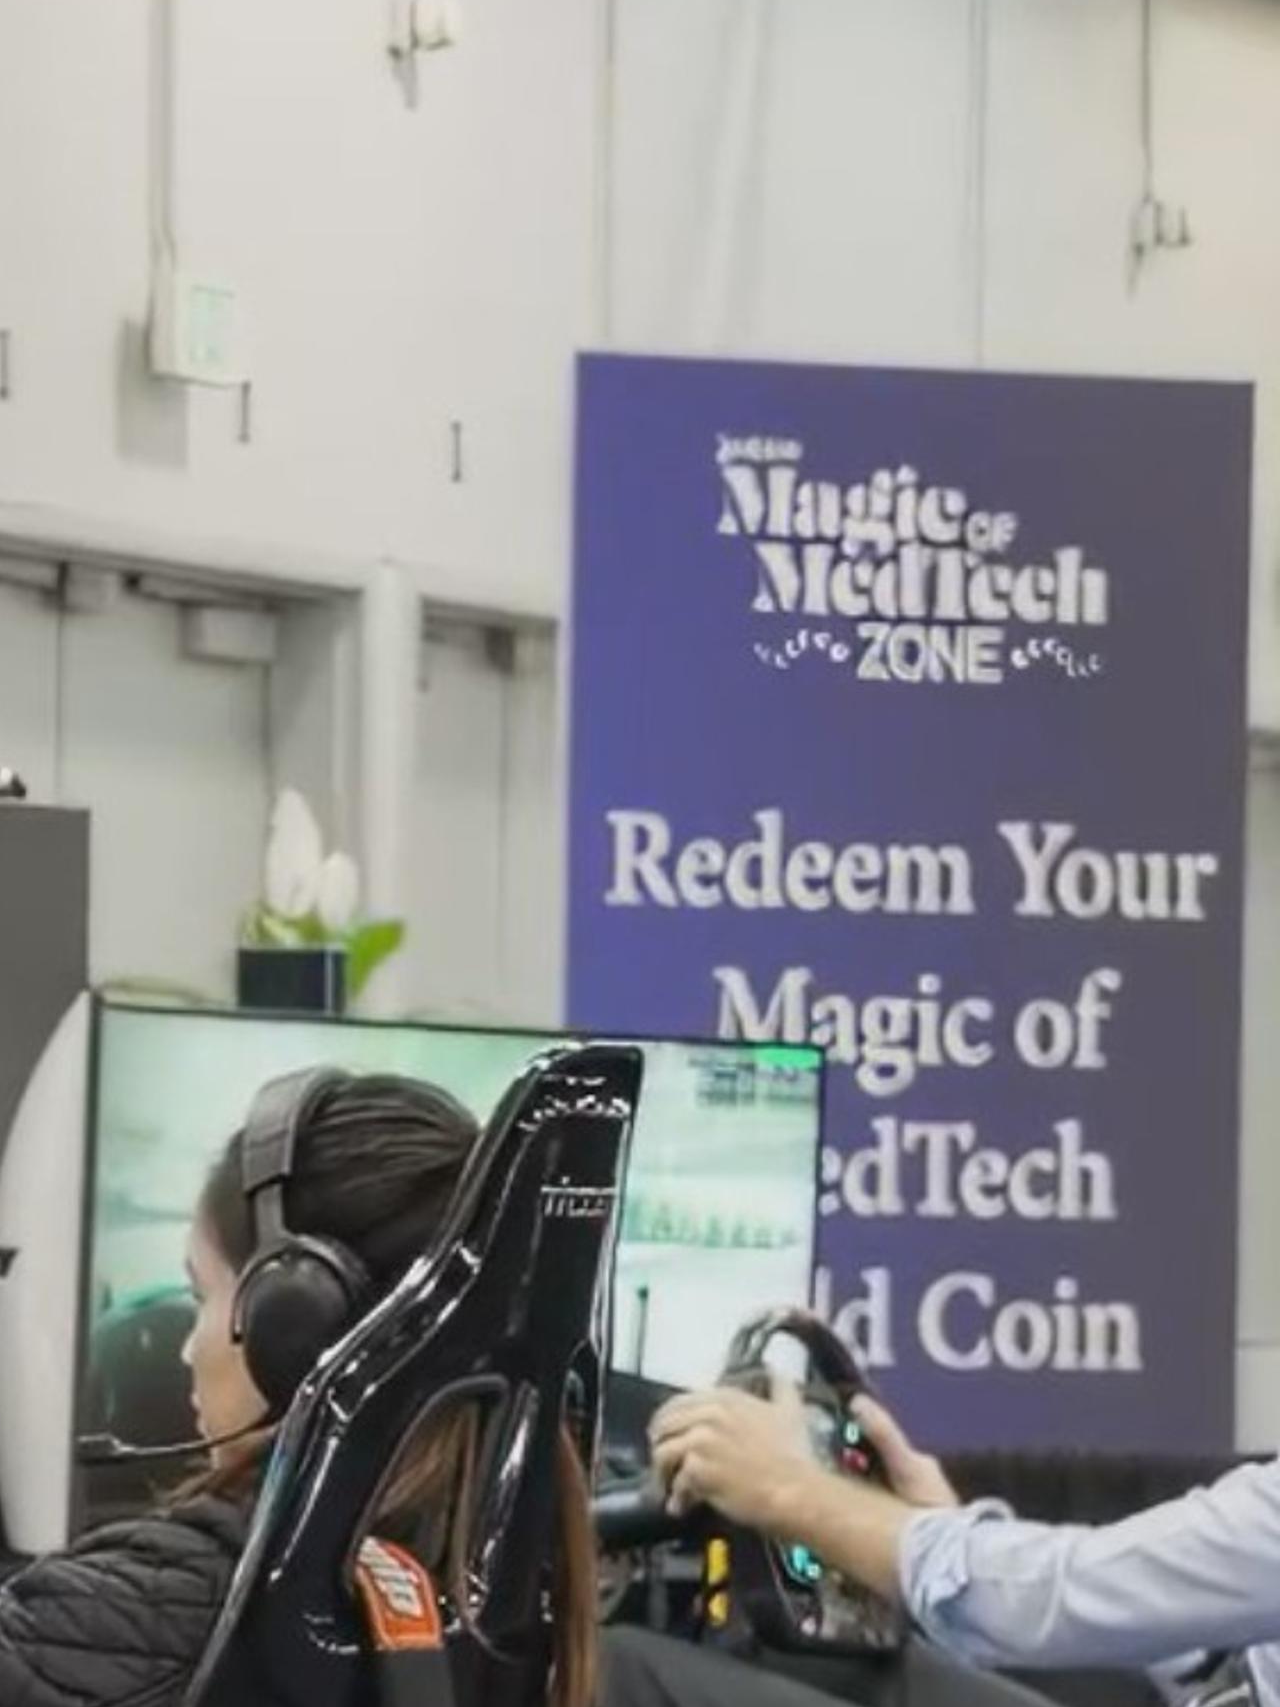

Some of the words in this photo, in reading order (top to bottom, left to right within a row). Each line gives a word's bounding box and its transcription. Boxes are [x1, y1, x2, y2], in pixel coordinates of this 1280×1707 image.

[717, 465, 966, 557] Magic
[752, 543, 1108, 625] MedTech
[856, 622, 1005, 684] ZONE
[604, 808, 976, 915] Redeem
[998, 821, 1219, 921] Your
[713, 966, 995, 1096] Magic
[1014, 968, 1122, 1069] of
[917, 1272, 1143, 1371] Coin
